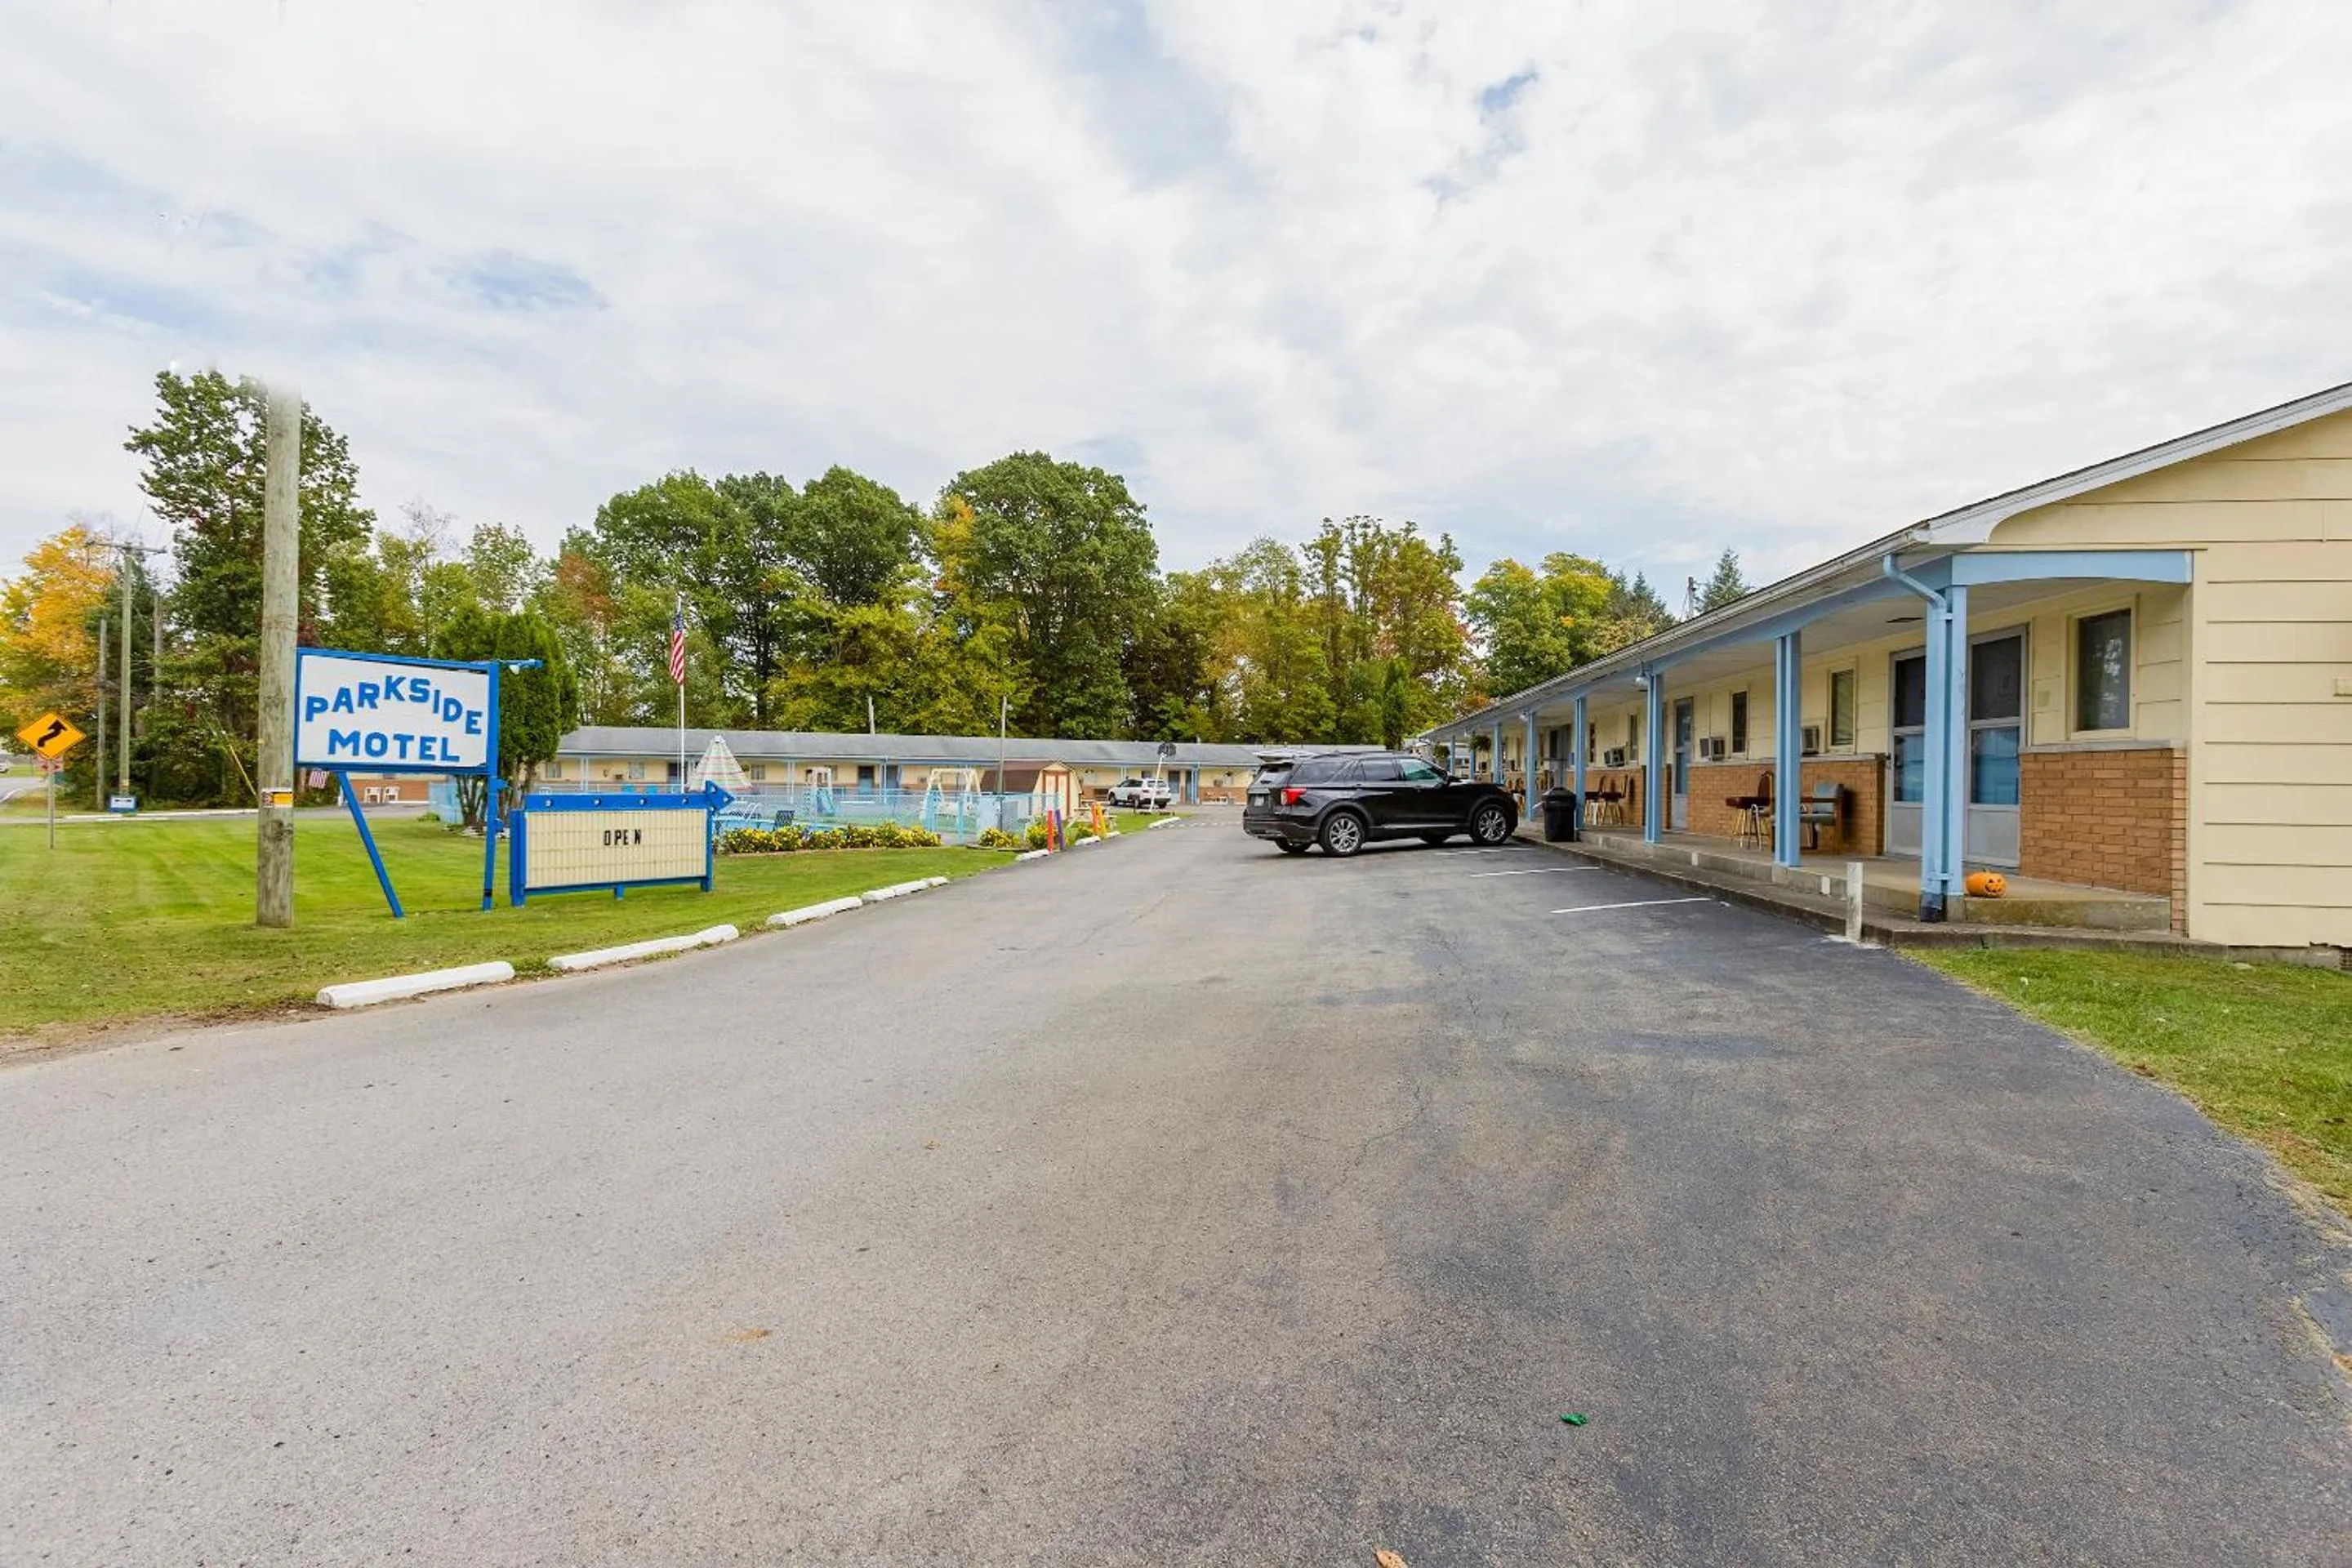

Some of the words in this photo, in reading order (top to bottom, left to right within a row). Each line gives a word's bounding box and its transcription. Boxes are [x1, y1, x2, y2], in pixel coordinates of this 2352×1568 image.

[305, 675, 483, 734] PARKSIDE
[327, 728, 460, 762] MOTEL
[604, 829, 642, 845] OPEN
